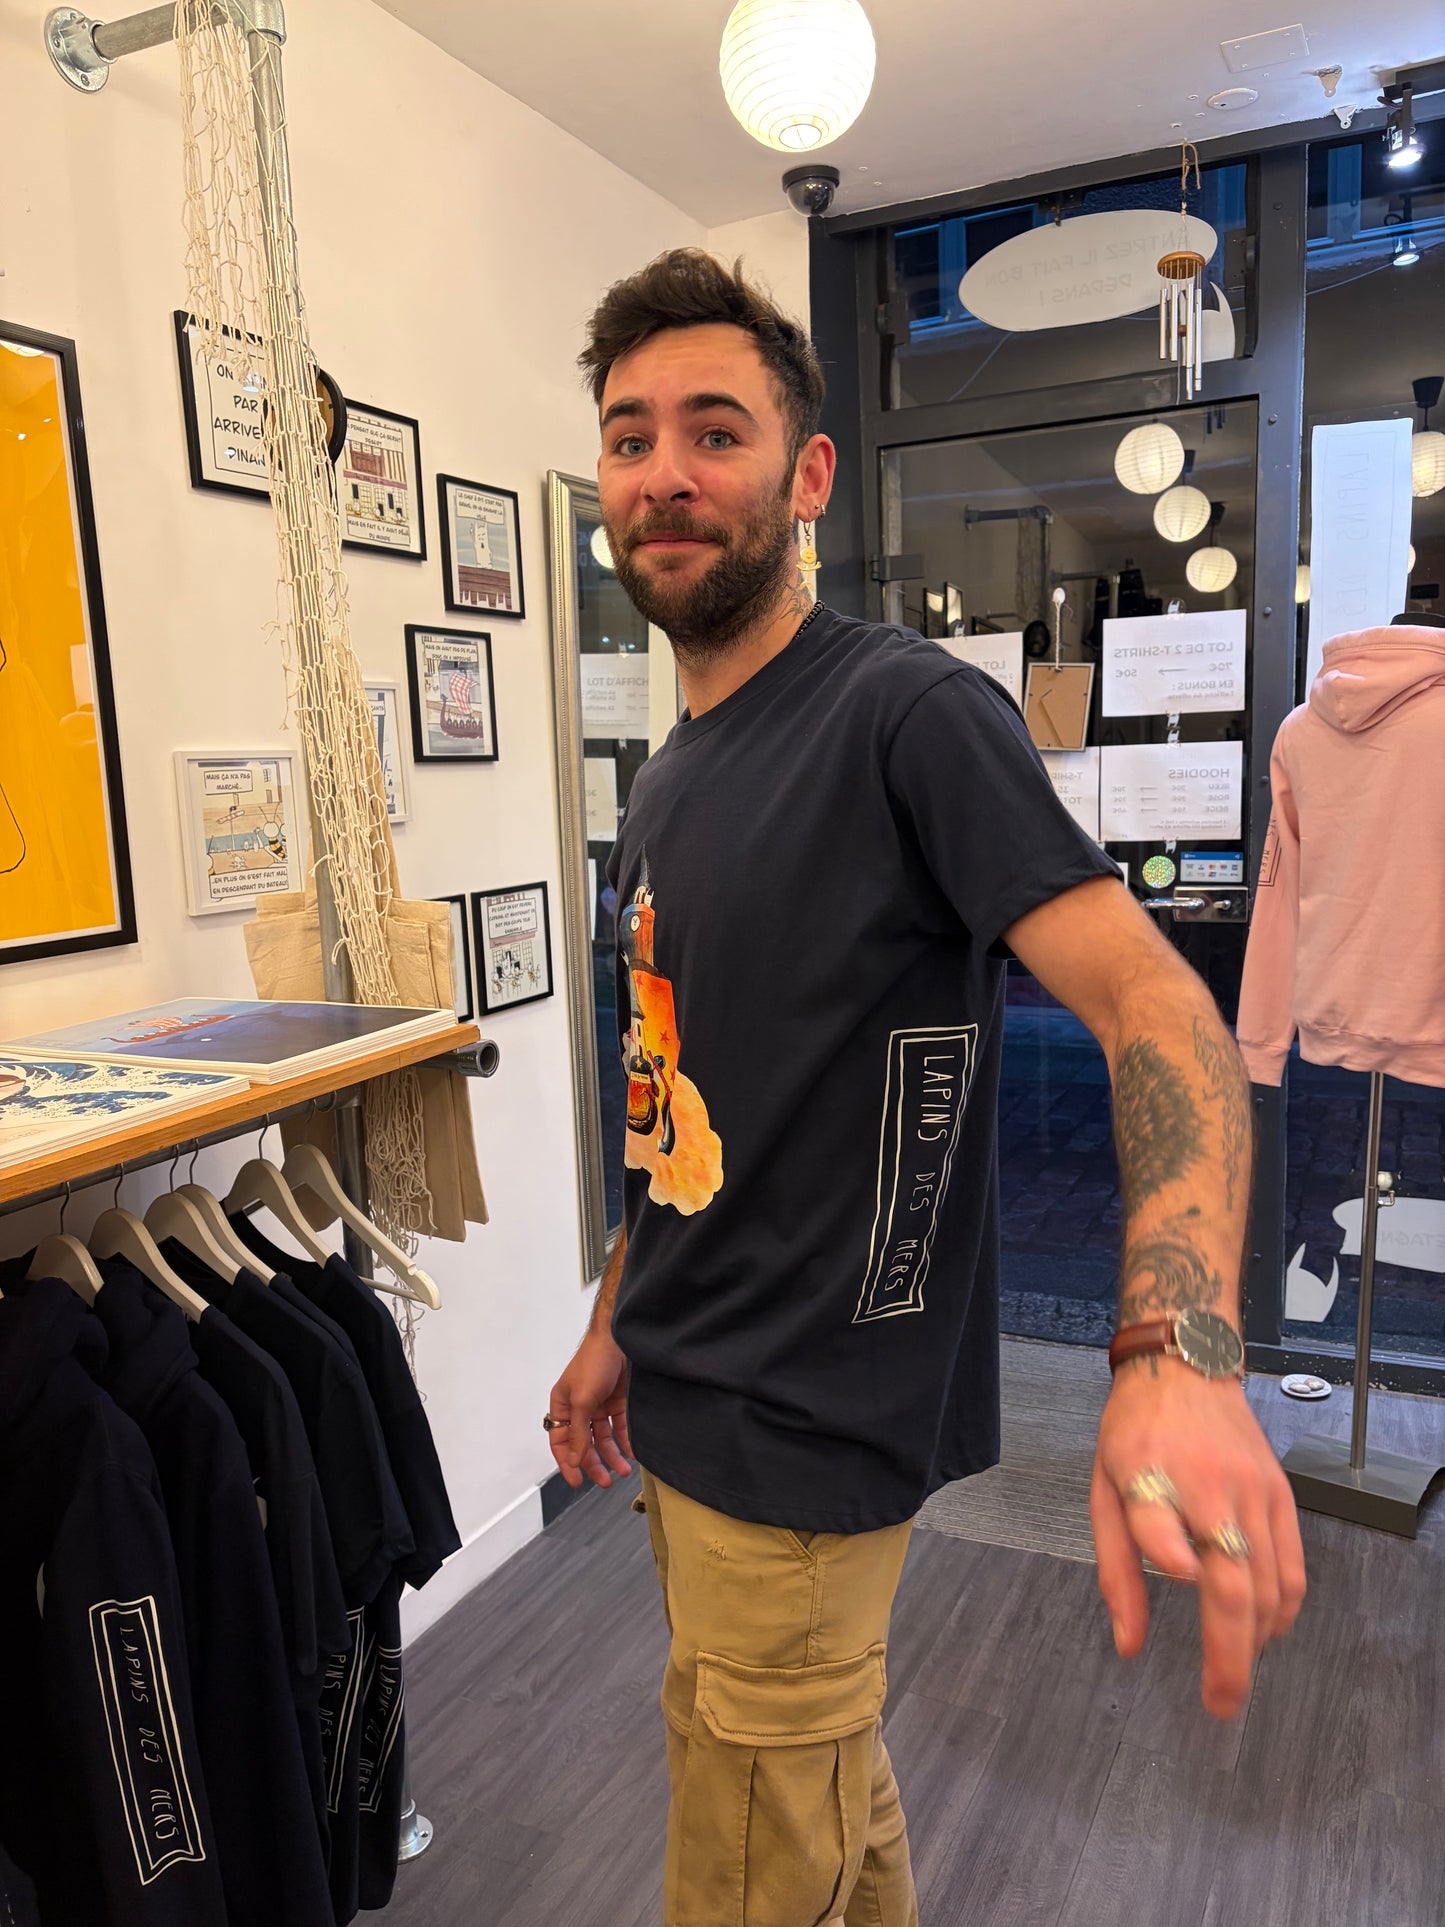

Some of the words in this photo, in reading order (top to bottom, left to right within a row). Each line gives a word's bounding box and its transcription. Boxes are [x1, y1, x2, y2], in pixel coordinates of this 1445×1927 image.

[217, 364, 233, 380] ON
[233, 395, 258, 413] PAR
[214, 416, 261, 440] ARRIVE
[587, 677, 605, 686] LOT
[606, 676, 649, 687] D'AFFICH
[223, 875, 238, 883] PLUS
[917, 1055, 955, 1142] LAPINS
[909, 1172, 936, 1212] DES
[884, 1239, 919, 1292] MERS
[120, 1626, 149, 1703] LAPINS
[322, 1654, 347, 1690] PINS
[138, 1727, 163, 1764] DES
[150, 1788, 180, 1840] MERS
